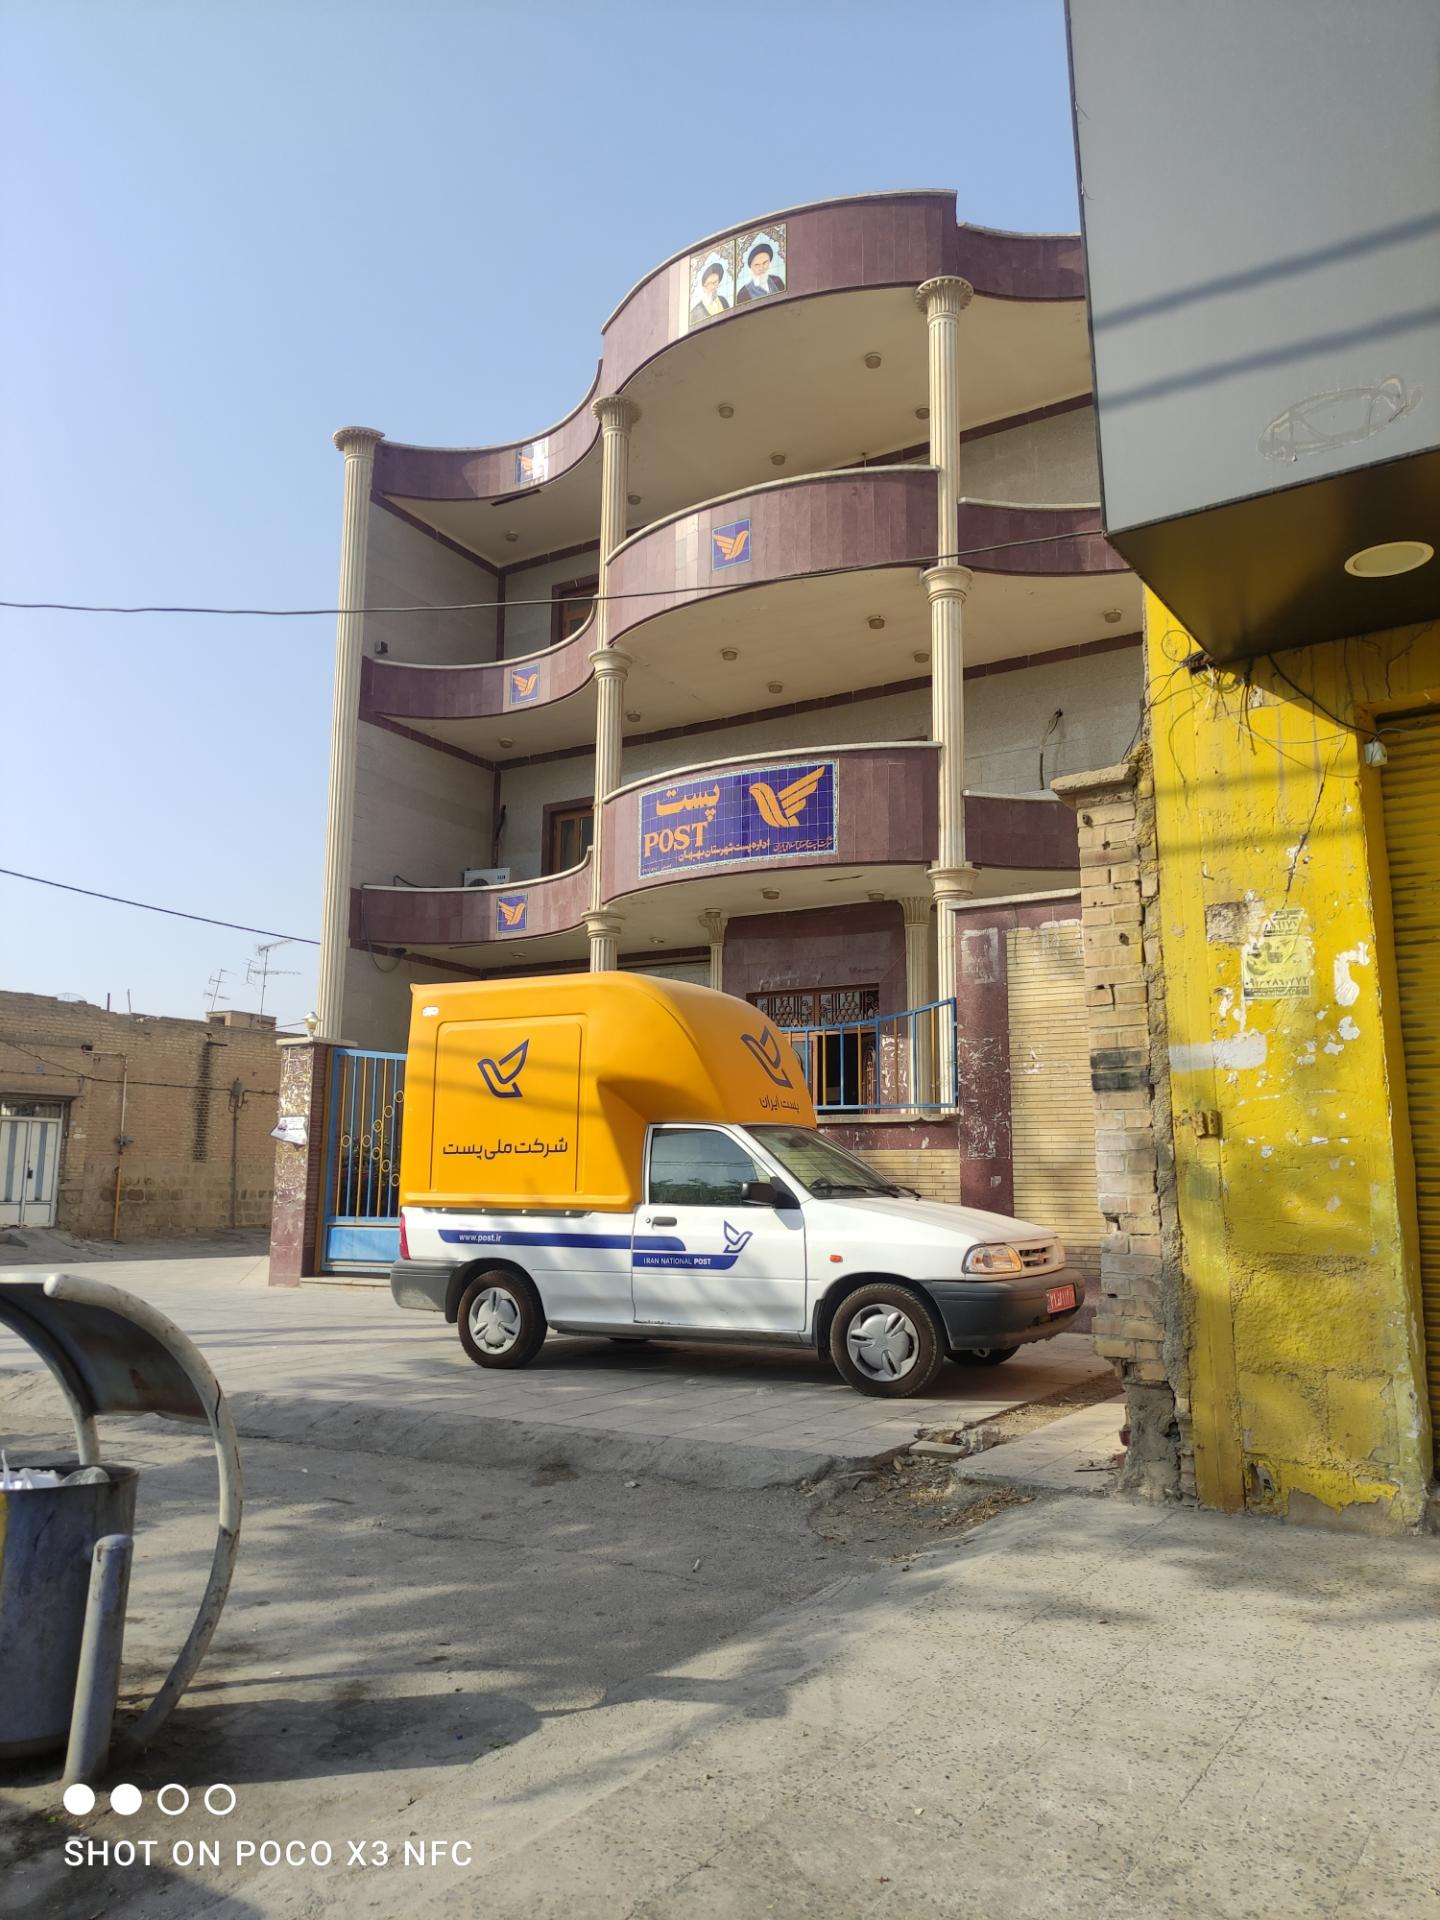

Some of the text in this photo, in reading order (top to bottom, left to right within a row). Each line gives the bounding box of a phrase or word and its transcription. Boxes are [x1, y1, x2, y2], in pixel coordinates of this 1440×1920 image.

[656, 784, 720, 822] پست
[644, 821, 708, 858] POST
[678, 837, 771, 862] اداره پست شهرستان بهبهان
[760, 1095, 800, 1114] پست ایران
[443, 1137, 568, 1160] شرکت ملی پست
[459, 1232, 502, 1243] www.post.ir
[643, 1256, 712, 1265] IRAN NATIONAL POST
